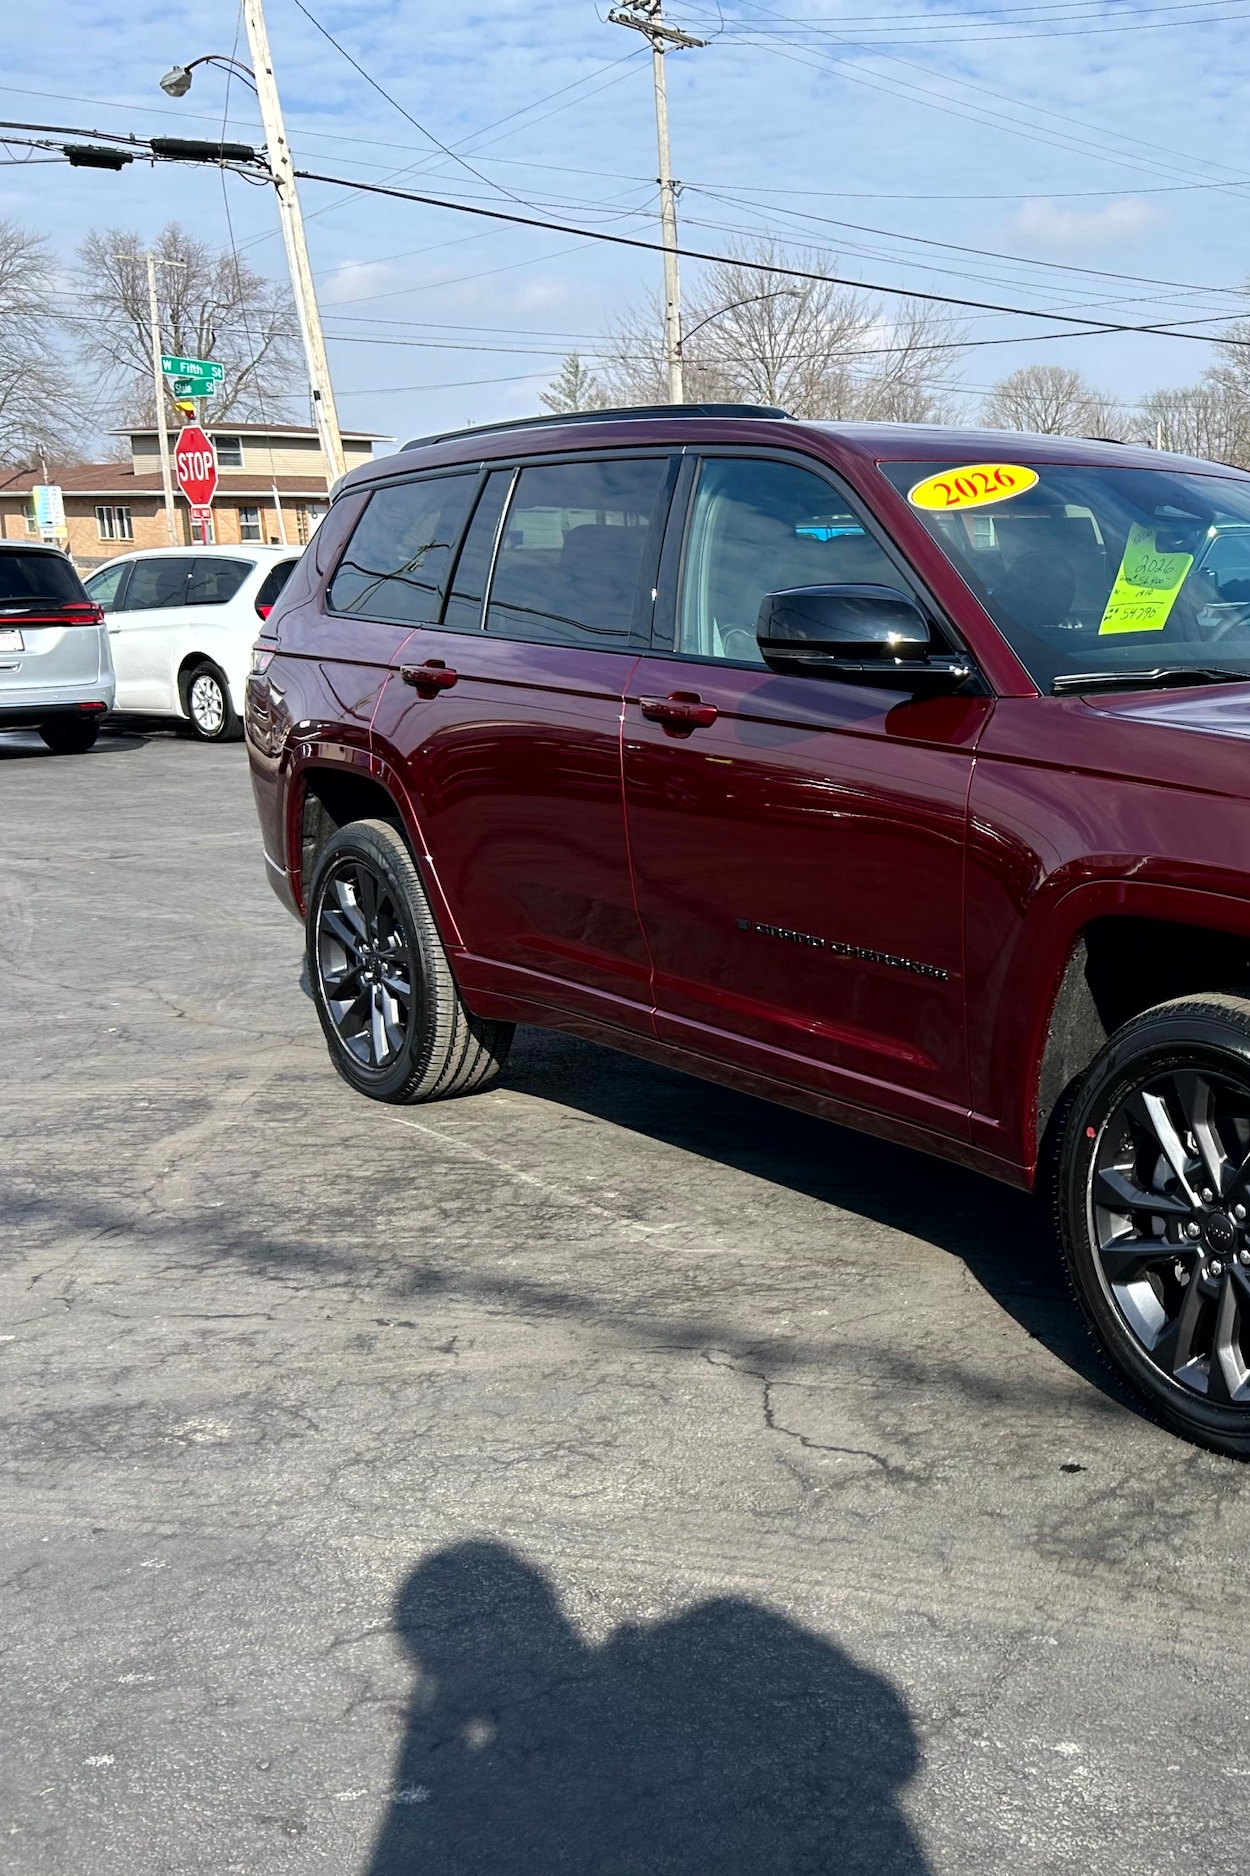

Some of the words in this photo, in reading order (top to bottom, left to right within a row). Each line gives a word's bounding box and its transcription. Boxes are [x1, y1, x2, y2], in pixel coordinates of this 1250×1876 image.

[163, 360, 172, 371] W
[180, 362, 203, 375] Fifth
[211, 366, 222, 378] St
[205, 381, 214, 393] St
[178, 450, 213, 482] STOP
[933, 468, 1016, 506] 2026
[1135, 554, 1174, 574] 2026
[754, 921, 825, 947] GRAND
[829, 940, 949, 981] CHEROKEE
